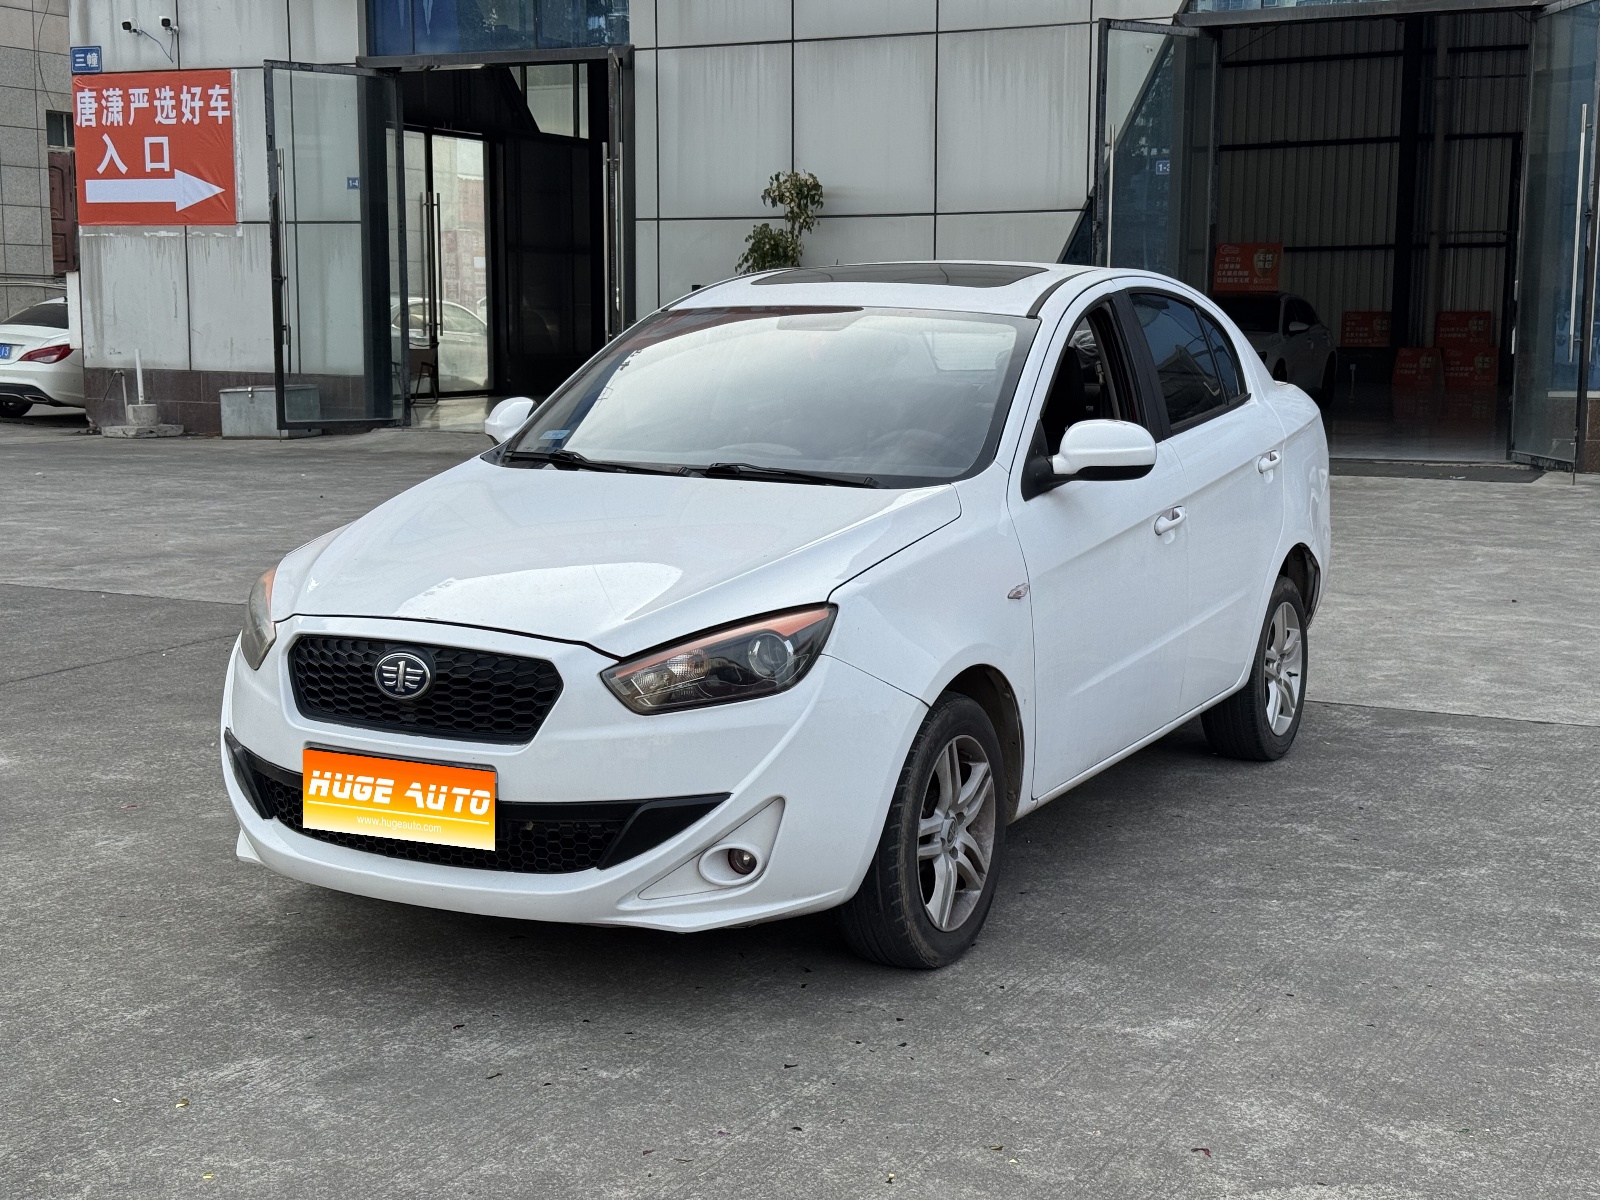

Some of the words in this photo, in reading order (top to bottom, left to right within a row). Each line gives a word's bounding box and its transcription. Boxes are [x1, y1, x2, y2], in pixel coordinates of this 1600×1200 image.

[74, 52, 99, 68] 三幢
[75, 84, 231, 128] 唐潇严选好车
[96, 133, 171, 175] 入口
